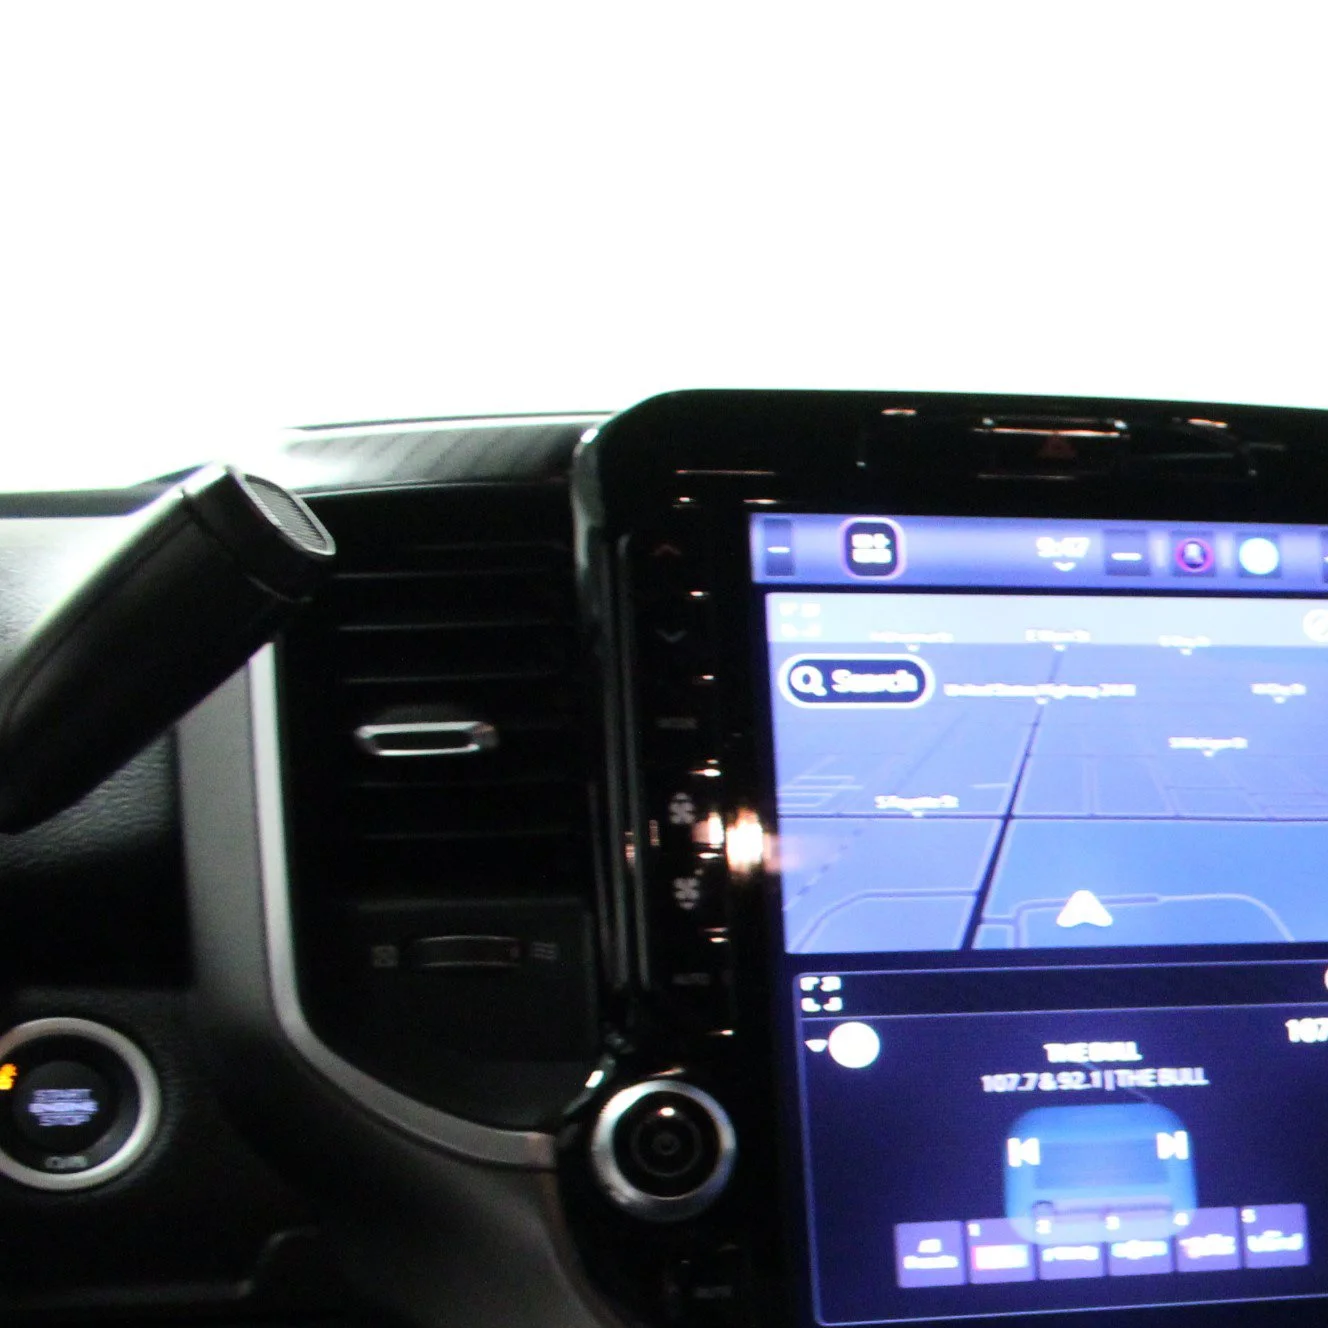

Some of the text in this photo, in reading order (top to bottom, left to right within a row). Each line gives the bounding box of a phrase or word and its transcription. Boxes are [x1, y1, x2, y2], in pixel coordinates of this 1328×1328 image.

[832, 669, 918, 693] Search
[980, 1072, 1038, 1092] 107.7
[1056, 1071, 1103, 1090] 92.1
[1114, 1069, 1156, 1088] THE
[1156, 1067, 1210, 1087] BULL
